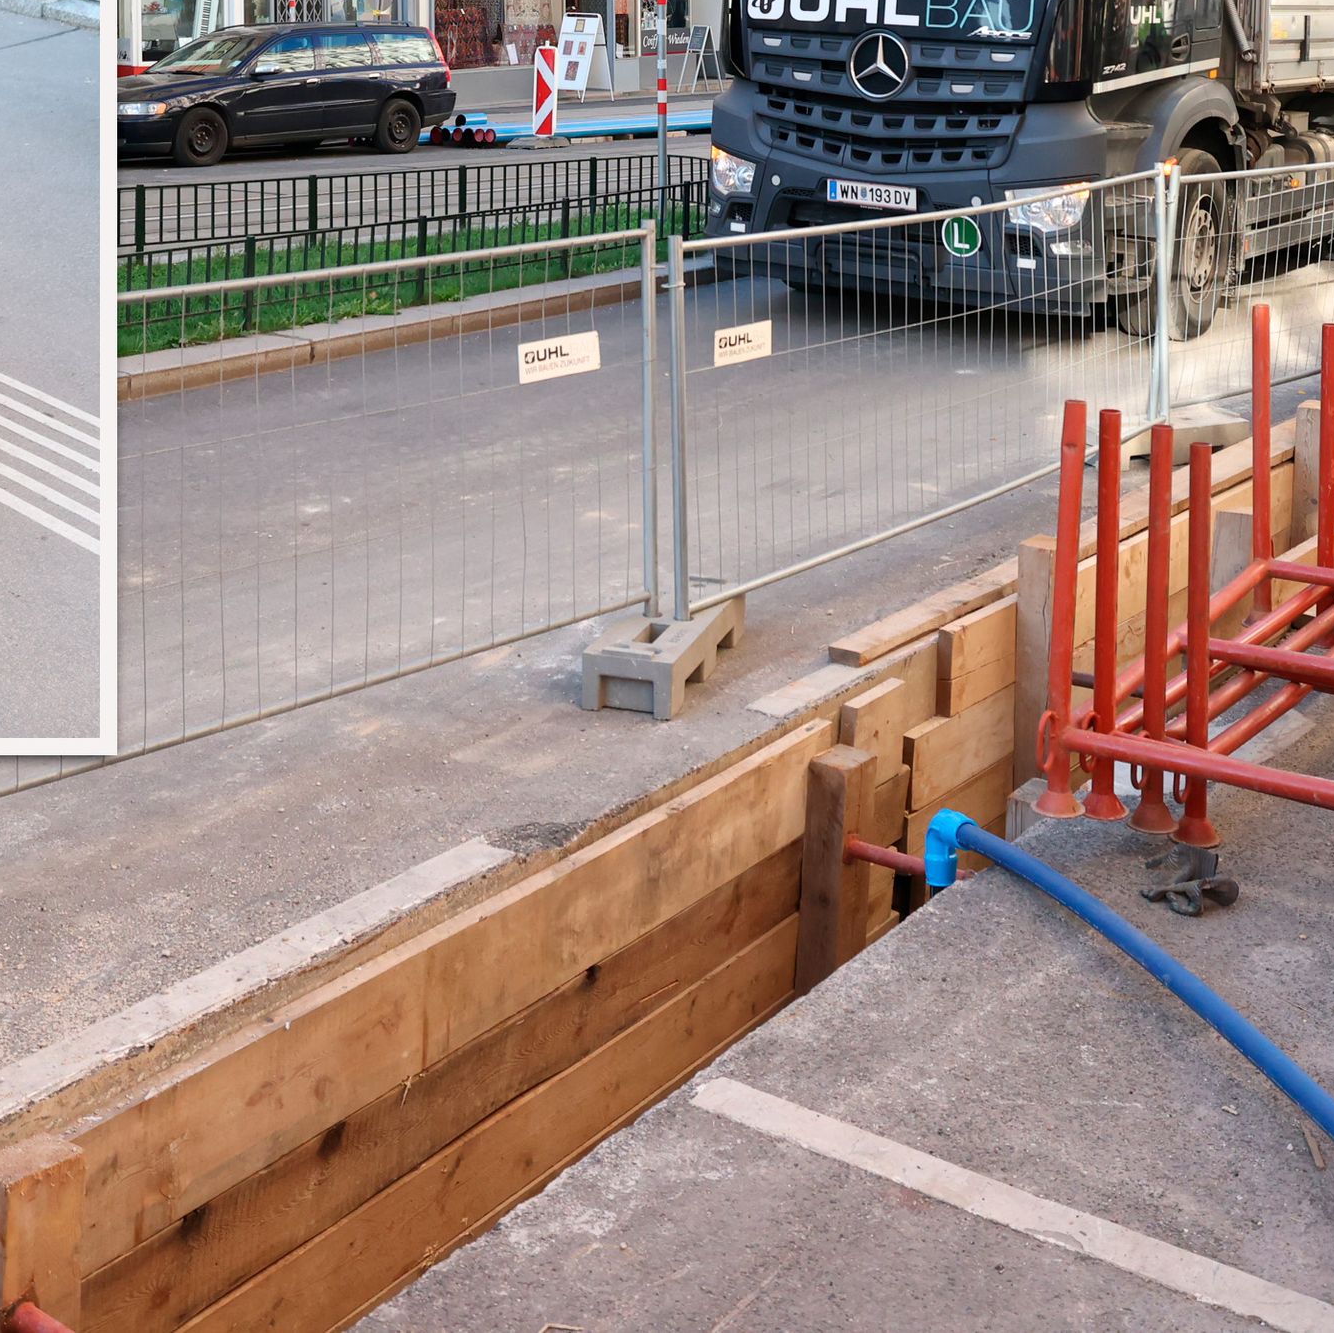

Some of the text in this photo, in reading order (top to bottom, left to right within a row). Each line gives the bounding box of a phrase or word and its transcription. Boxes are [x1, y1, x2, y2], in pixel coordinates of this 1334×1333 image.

[1130, 5, 1161, 25] UHL
[840, 184, 911, 206] WN 193 DV
[953, 222, 970, 249] L
[728, 332, 752, 347] UHL
[536, 345, 570, 362] UHL
